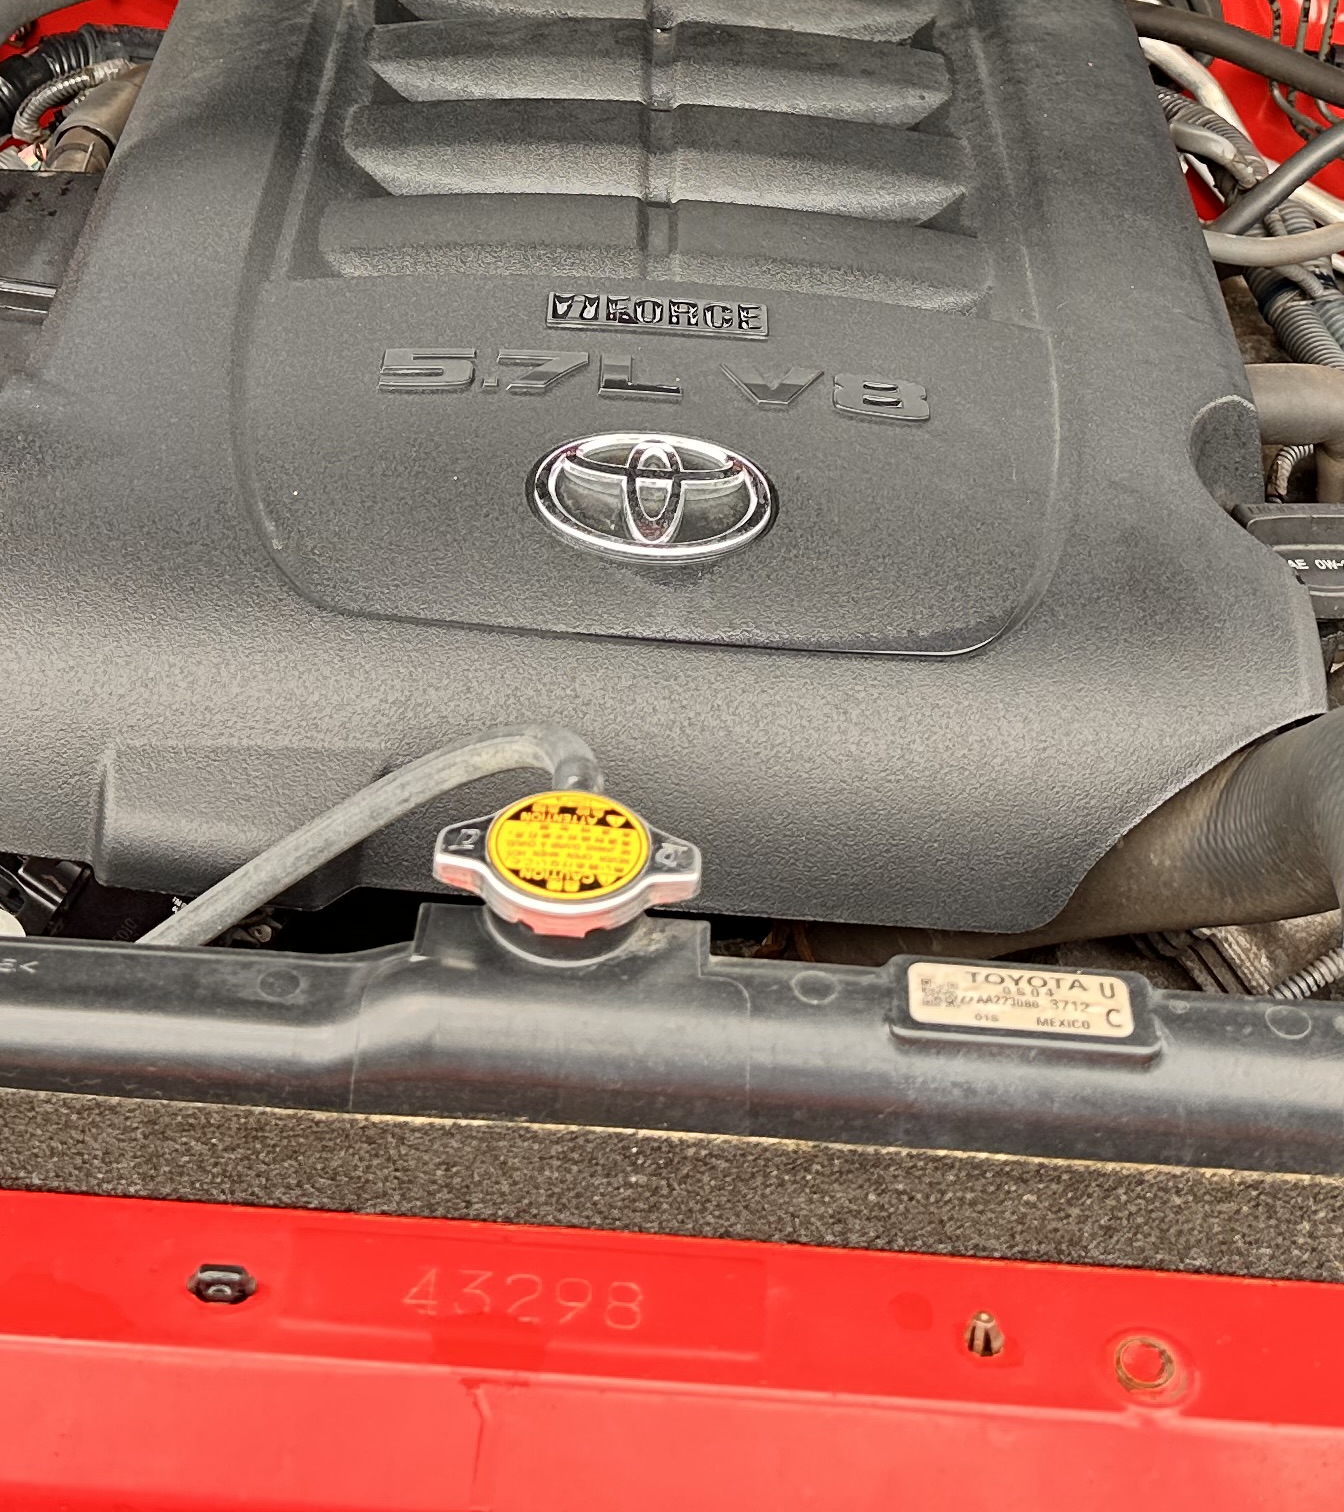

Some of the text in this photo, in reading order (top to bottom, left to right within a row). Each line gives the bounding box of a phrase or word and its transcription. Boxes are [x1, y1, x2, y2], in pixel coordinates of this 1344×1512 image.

[377, 347, 932, 422] 5.7L V8
[1287, 559, 1310, 571] AE
[520, 811, 598, 826] ATTENTION
[518, 869, 596, 885] CAUTION
[964, 971, 1088, 991] TOYOTA
[1099, 981, 1116, 999] U
[1036, 1016, 1091, 1030] MEXICO
[1105, 1008, 1123, 1028] C
[402, 1267, 644, 1331] 43298
